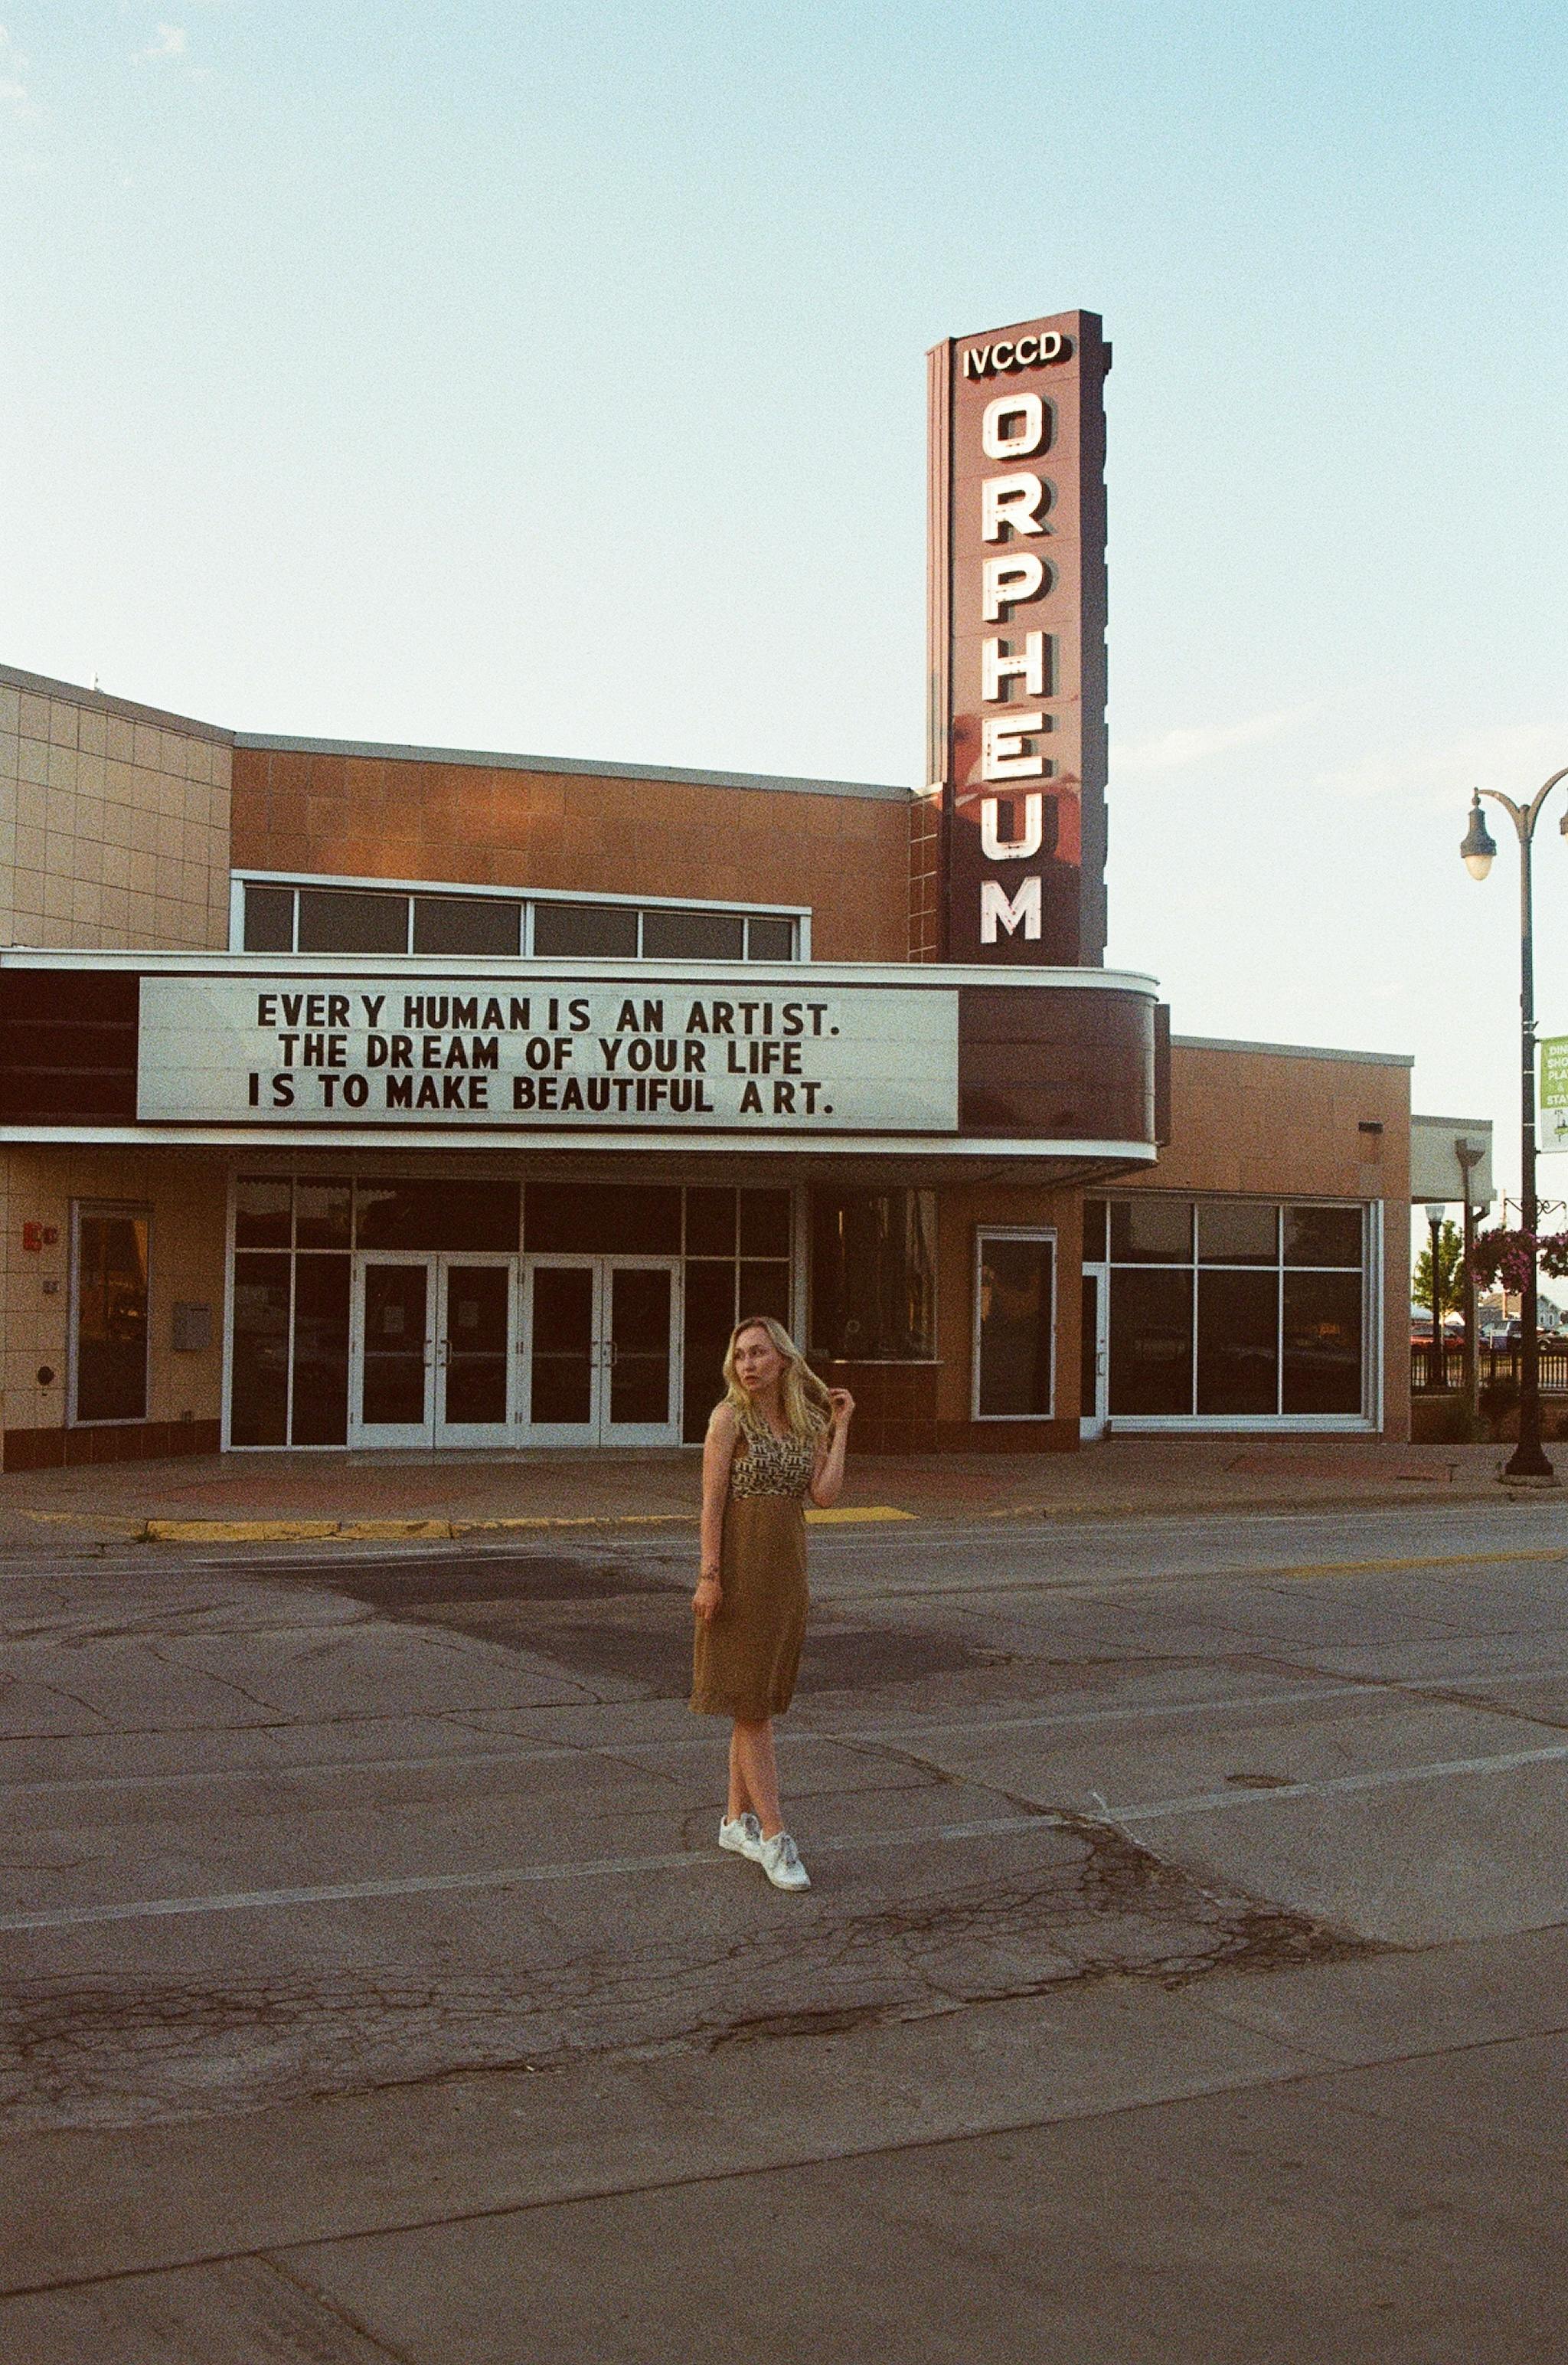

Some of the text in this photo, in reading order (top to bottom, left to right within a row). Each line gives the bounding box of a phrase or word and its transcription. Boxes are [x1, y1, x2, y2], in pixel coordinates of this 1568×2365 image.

[963, 331, 1061, 378] IVCCD
[981, 392, 1044, 944] ORPHEUM
[259, 995, 838, 1035] EVERY HUMAN IS AN ARTIST.
[279, 1034, 802, 1074] THE DREAM OF YOUR LIFE
[1547, 1056, 1568, 1068] SHO
[1548, 1045, 1568, 1054] DIN
[249, 1073, 833, 1114] IS TO MAKE BEAUTIFUL ART.
[1548, 1068, 1568, 1081] PLA
[1547, 1094, 1568, 1105] STA
